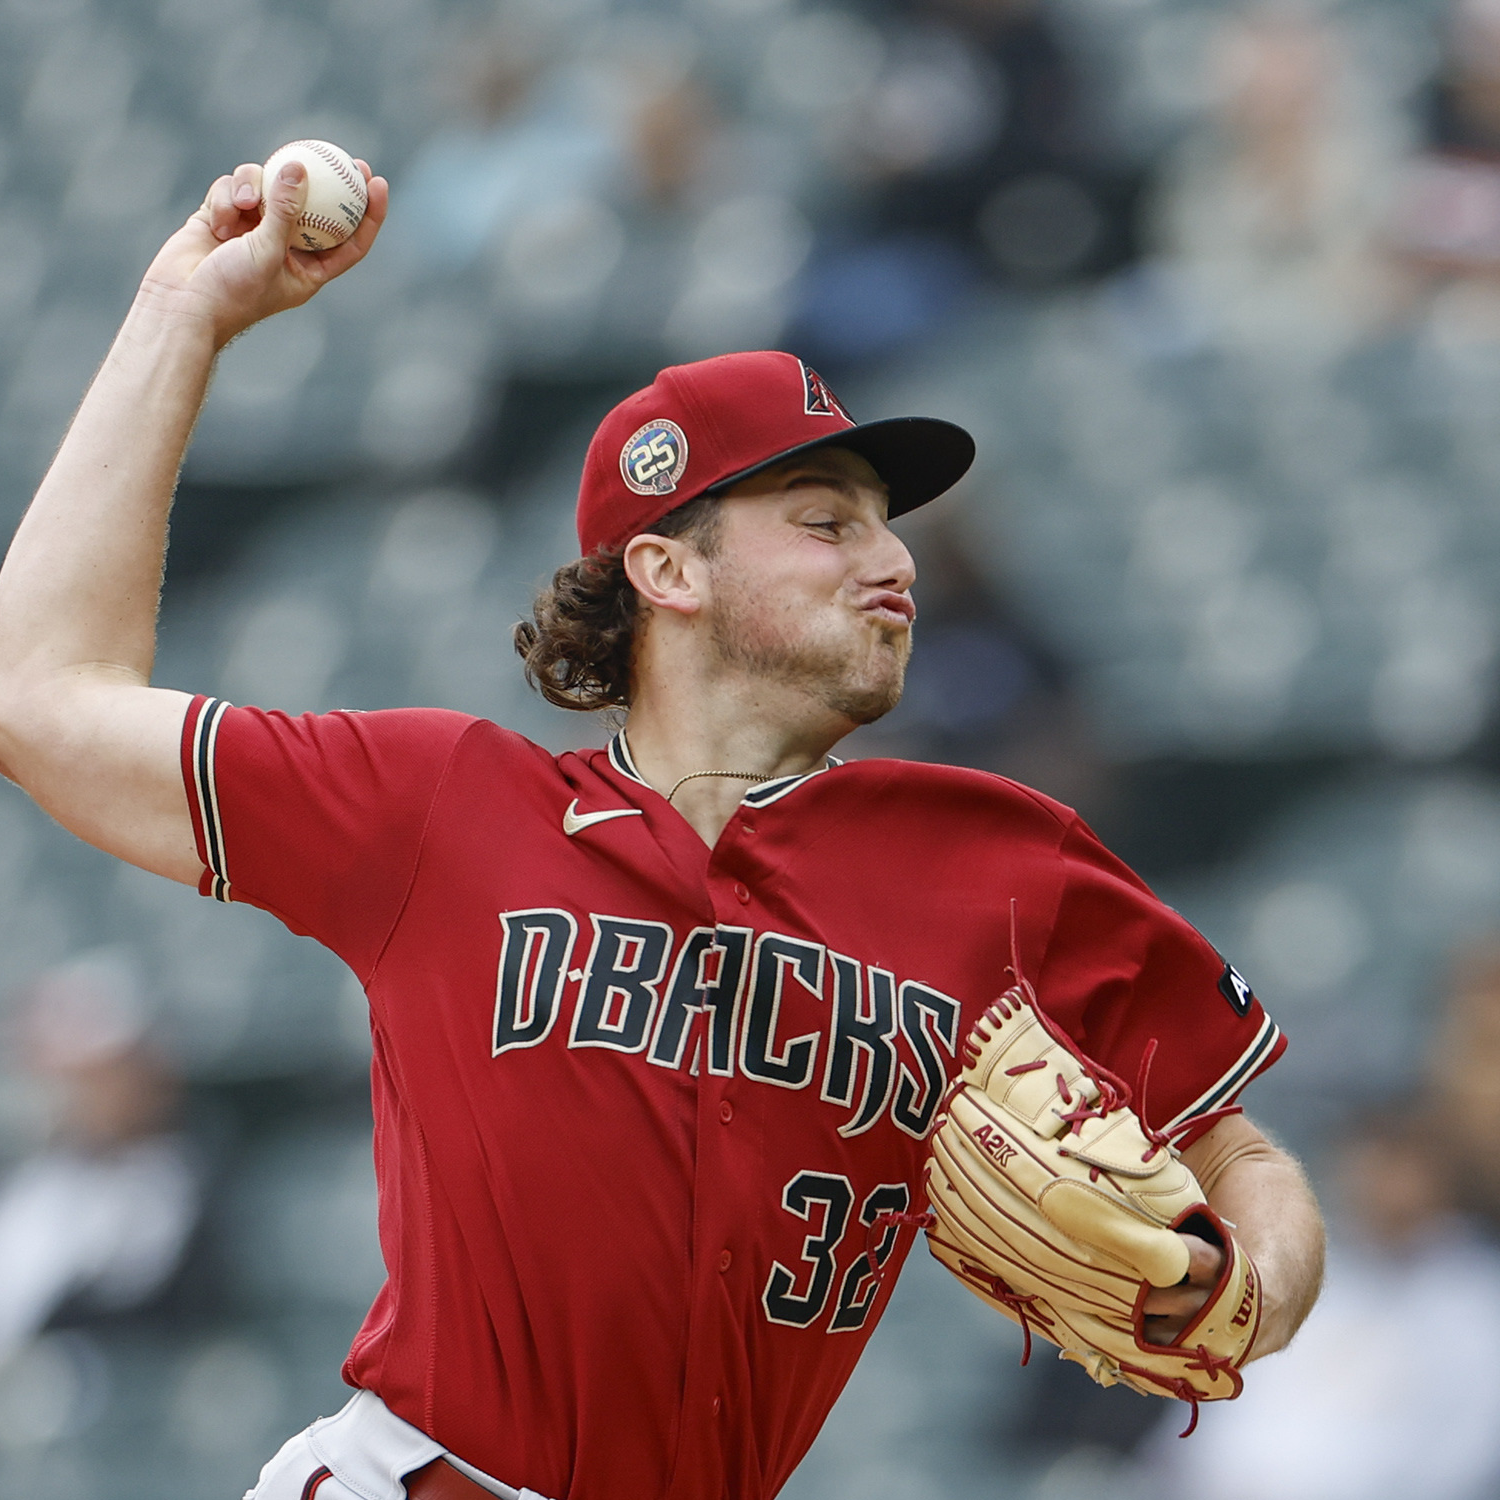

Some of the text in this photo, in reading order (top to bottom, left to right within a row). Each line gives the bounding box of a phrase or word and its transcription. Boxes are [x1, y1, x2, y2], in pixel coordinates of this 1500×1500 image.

[630, 431, 676, 483] 25
[972, 1123, 1019, 1168] A2K
[762, 1169, 910, 1334] 32
